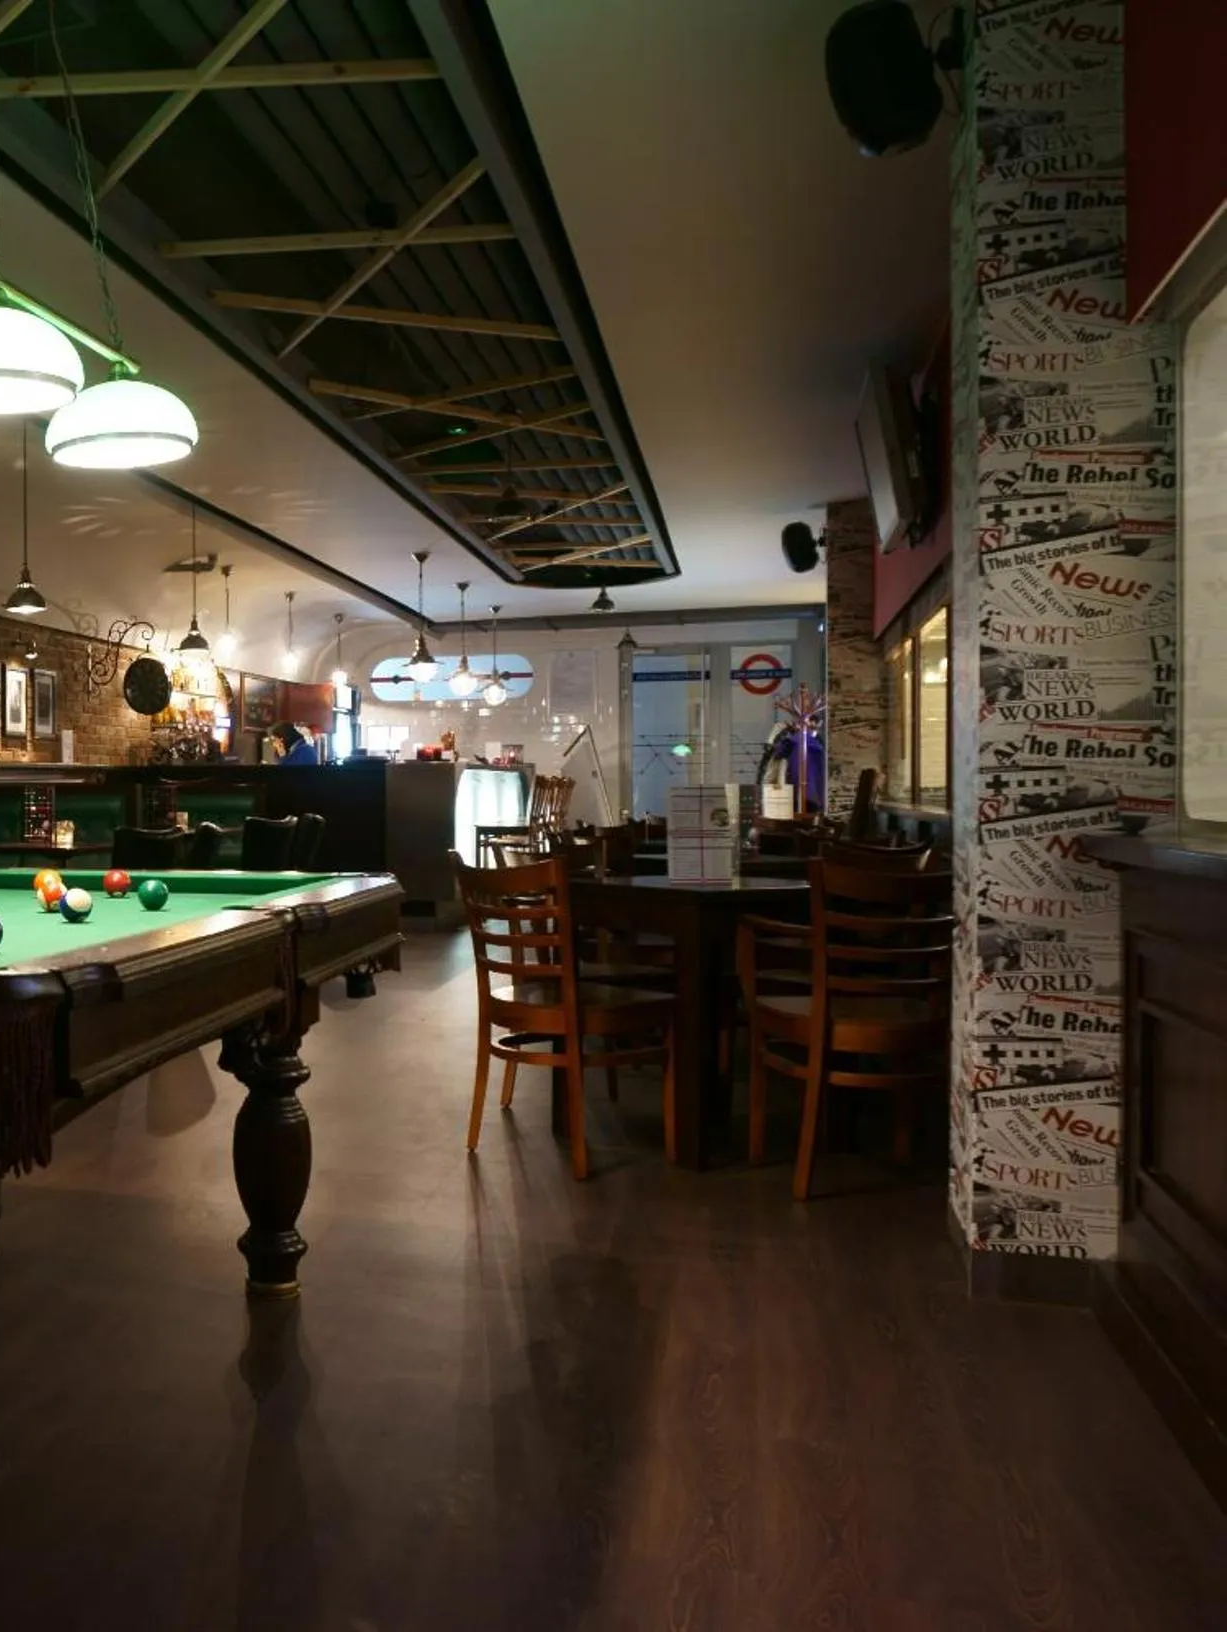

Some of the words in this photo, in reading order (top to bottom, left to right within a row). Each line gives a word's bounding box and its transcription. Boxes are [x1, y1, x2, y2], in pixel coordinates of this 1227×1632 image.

[995, 153, 1094, 182] WORLD
[987, 352, 1085, 373] SPORTS
[1027, 403, 1096, 425] NEWS
[997, 426, 1096, 451] WORLD
[1023, 462, 1059, 483] The
[987, 557, 1012, 570] The
[1014, 552, 1037, 566] big
[1038, 541, 1089, 560] stories
[1091, 536, 1107, 549] of
[1048, 560, 1153, 601] News
[988, 622, 1085, 645] SPORTS
[1026, 680, 1094, 697] NEWS
[996, 700, 1095, 721] WORLD
[1022, 734, 1058, 757] The
[985, 827, 1010, 841] The
[1012, 821, 1034, 837] big
[1036, 814, 1088, 834] stories
[988, 893, 1083, 919] SPORTS
[1023, 952, 1092, 970] NEWS
[995, 975, 1093, 992] WORLD
[1018, 1005, 1055, 1029] The
[982, 1096, 1006, 1109] The
[1009, 1092, 1031, 1107] big
[1032, 1090, 1084, 1104] stories
[1087, 1085, 1102, 1099] of
[983, 1160, 1078, 1190] SPORTS
[1019, 1221, 1088, 1241] NEWS
